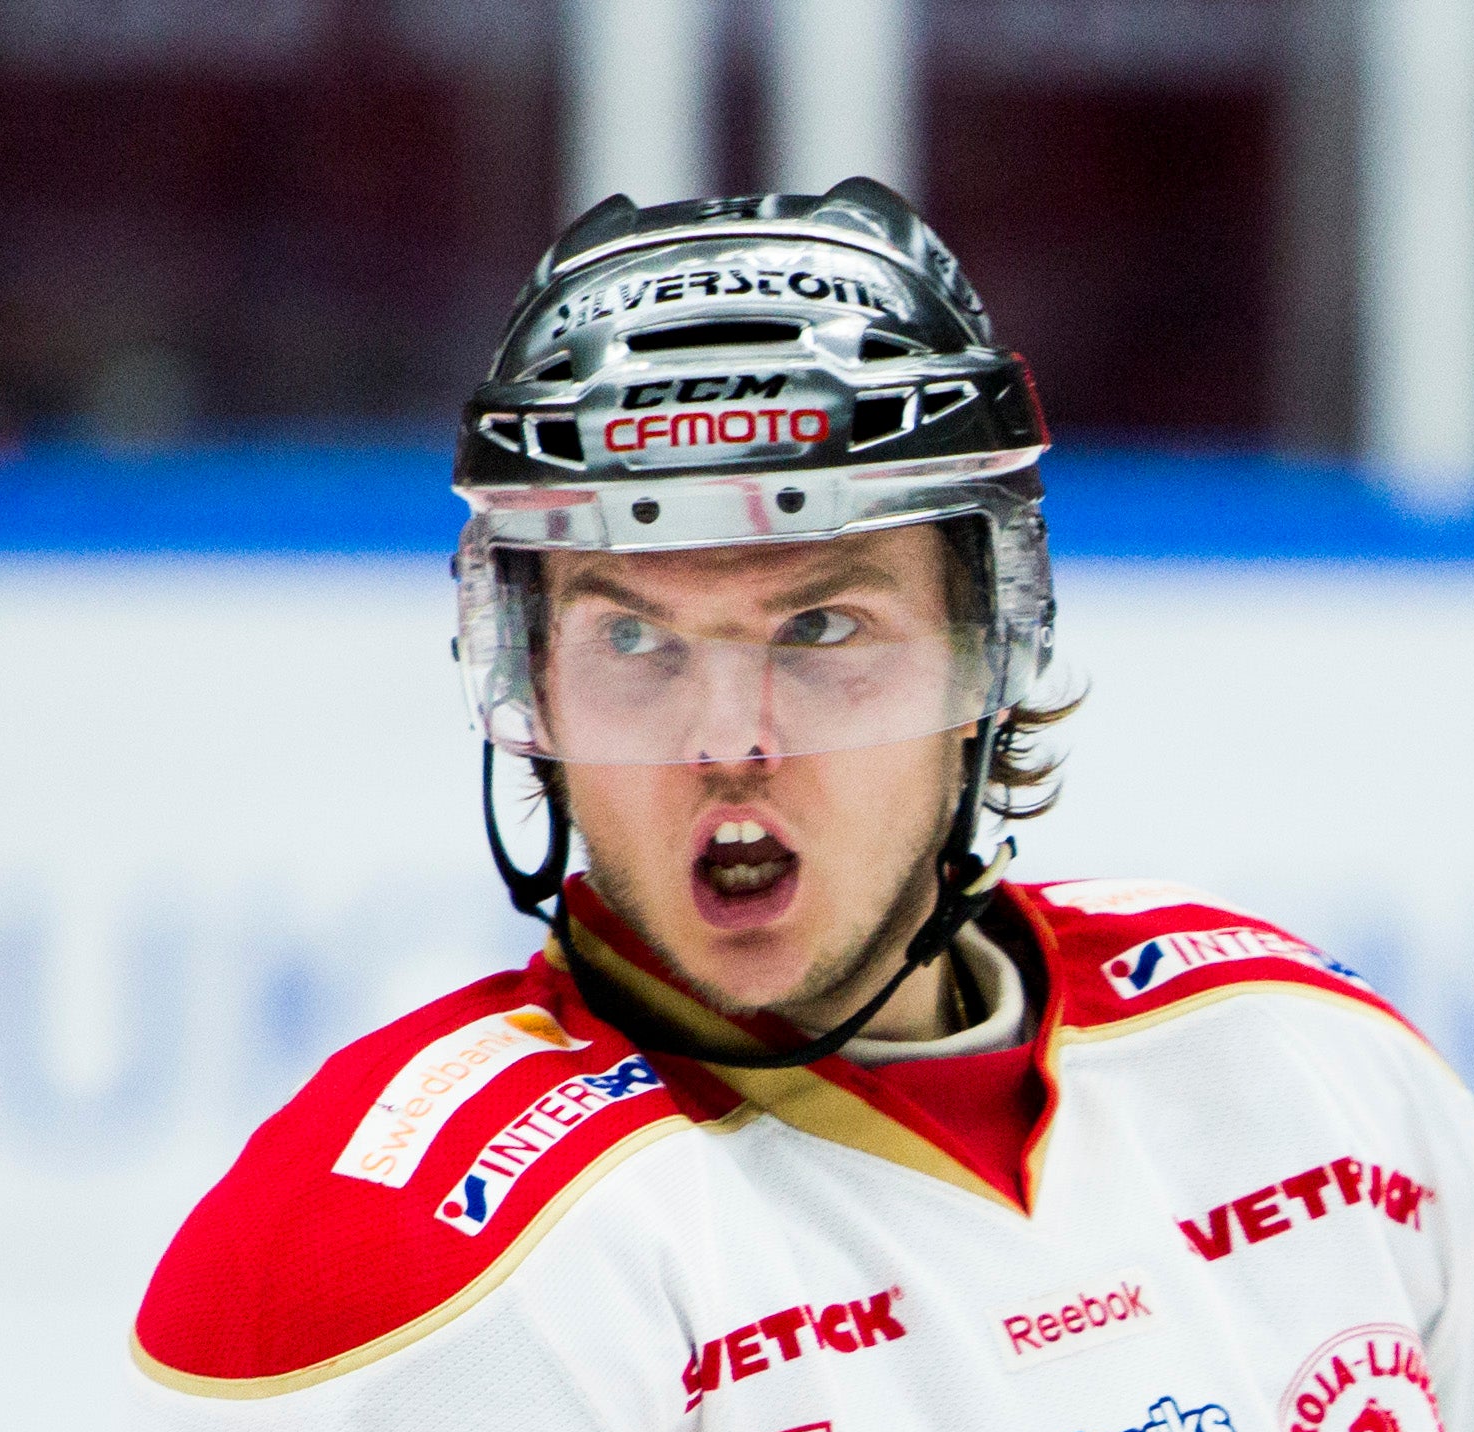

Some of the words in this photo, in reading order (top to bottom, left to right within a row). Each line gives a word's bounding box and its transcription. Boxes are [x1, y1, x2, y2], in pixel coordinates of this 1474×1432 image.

[621, 373, 788, 410] CCM
[603, 408, 830, 453] CFMOTO
[359, 1025, 523, 1177] Swedbank
[1002, 1281, 1153, 1355] Reebok
